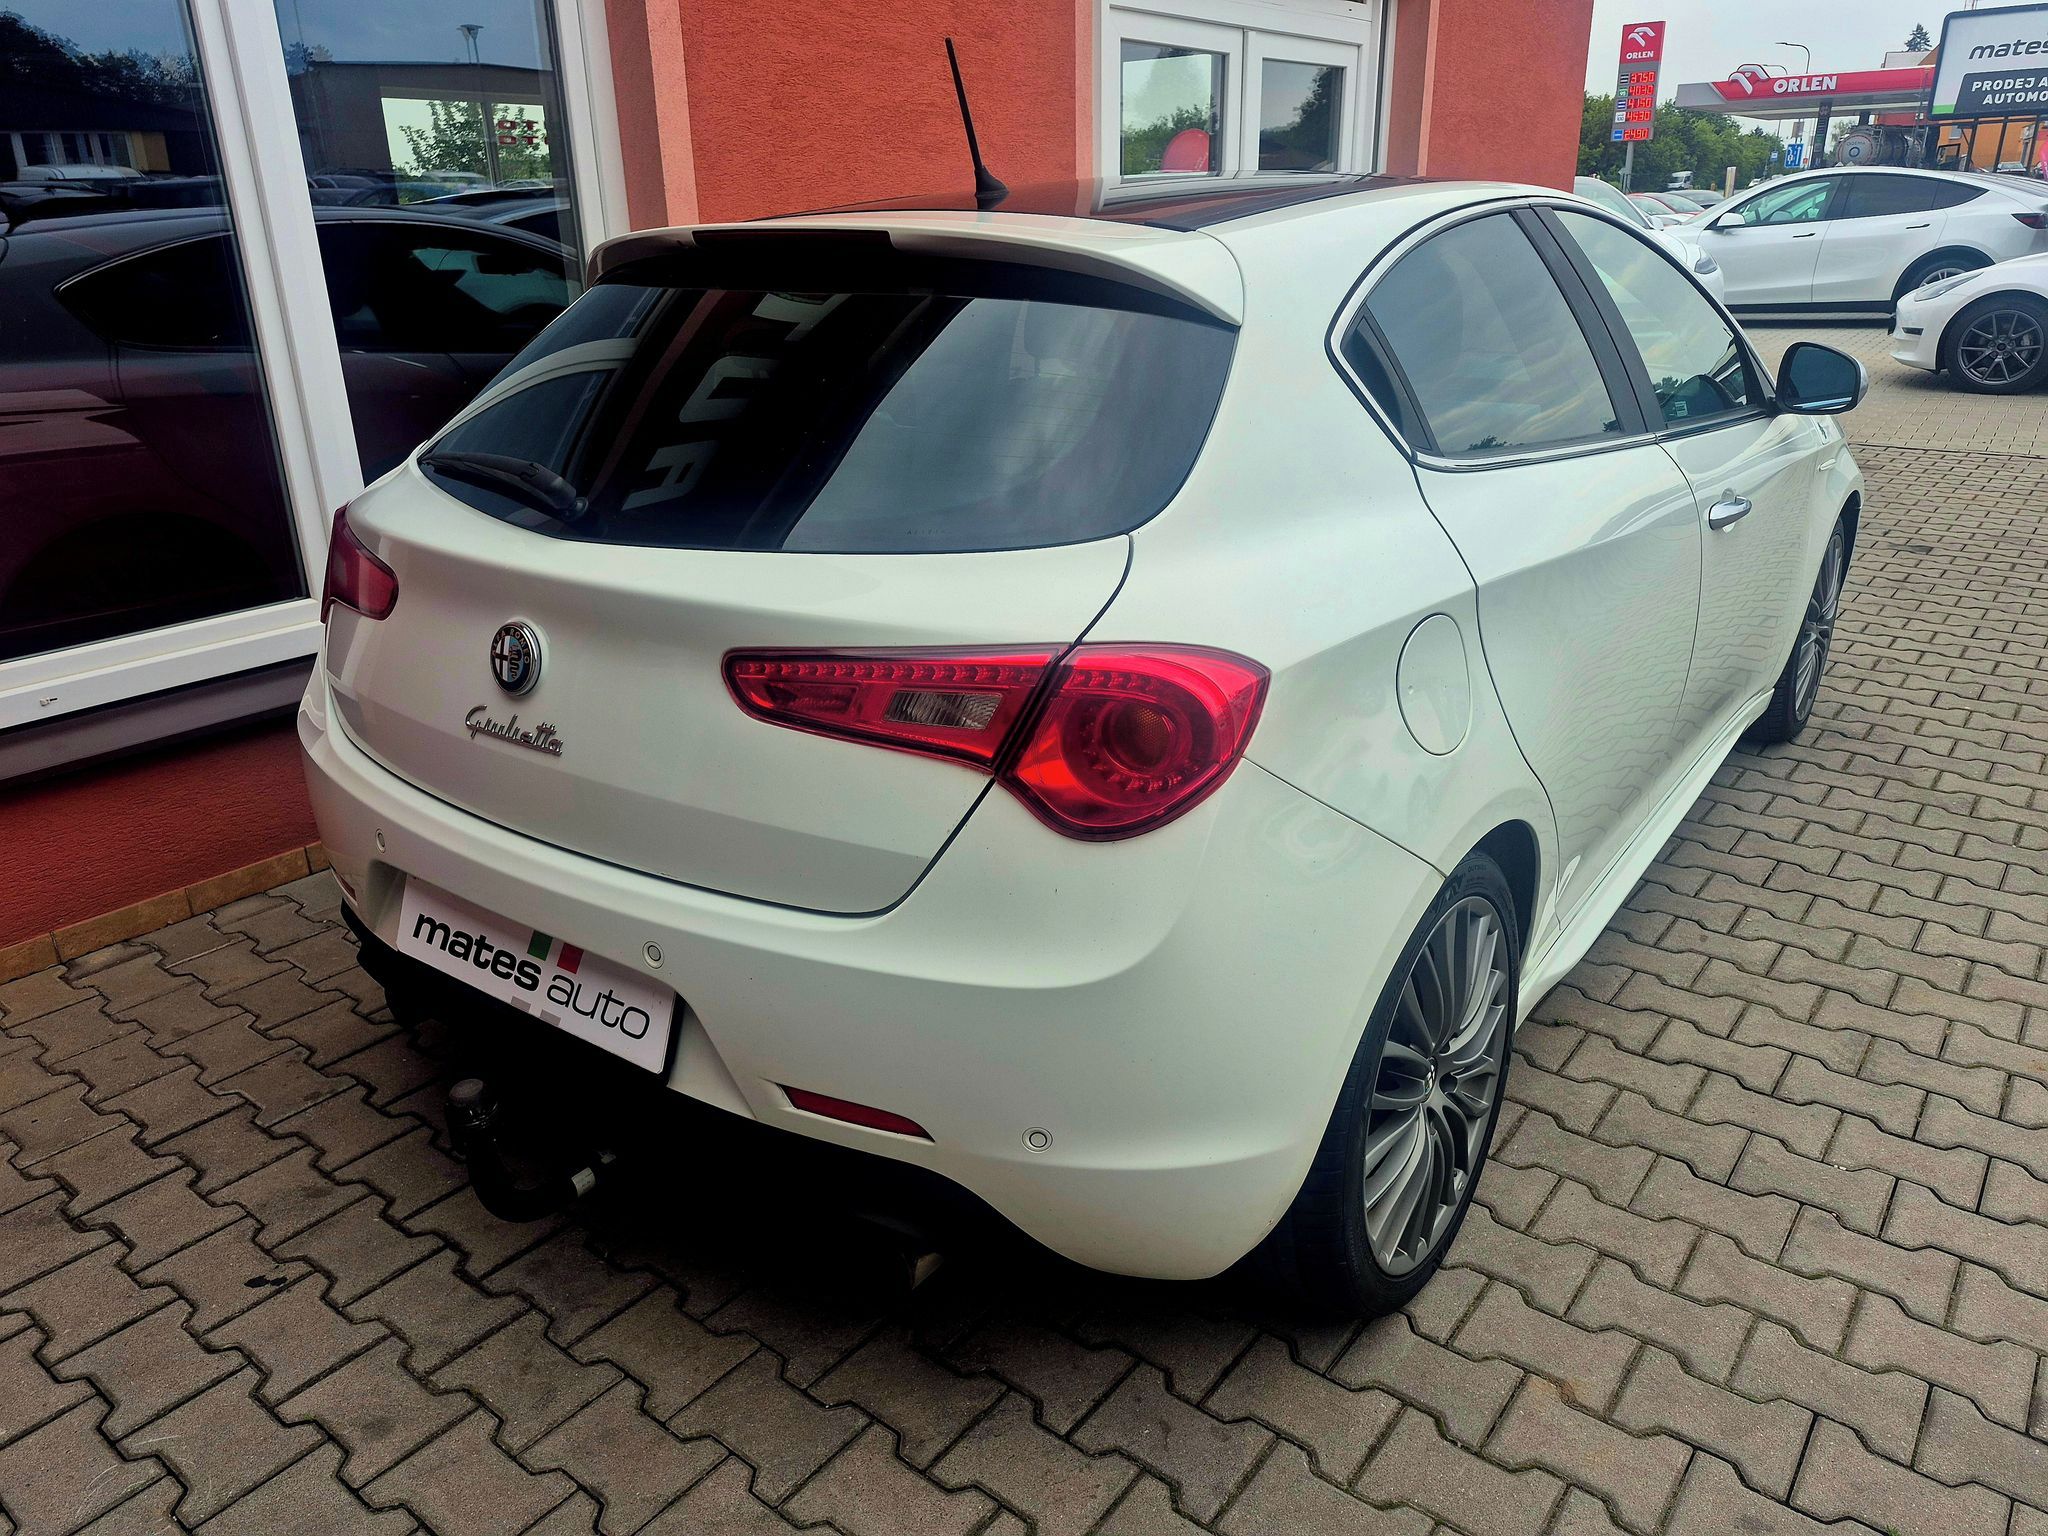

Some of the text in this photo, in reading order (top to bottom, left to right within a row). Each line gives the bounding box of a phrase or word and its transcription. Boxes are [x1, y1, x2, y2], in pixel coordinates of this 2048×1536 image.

[1626, 50, 1654, 60] ORLEN
[1773, 75, 1838, 94] ORLEN
[1971, 77, 2035, 92] PRODEJ
[465, 705, 564, 757] Giulietta
[412, 912, 651, 1040] mates auto
